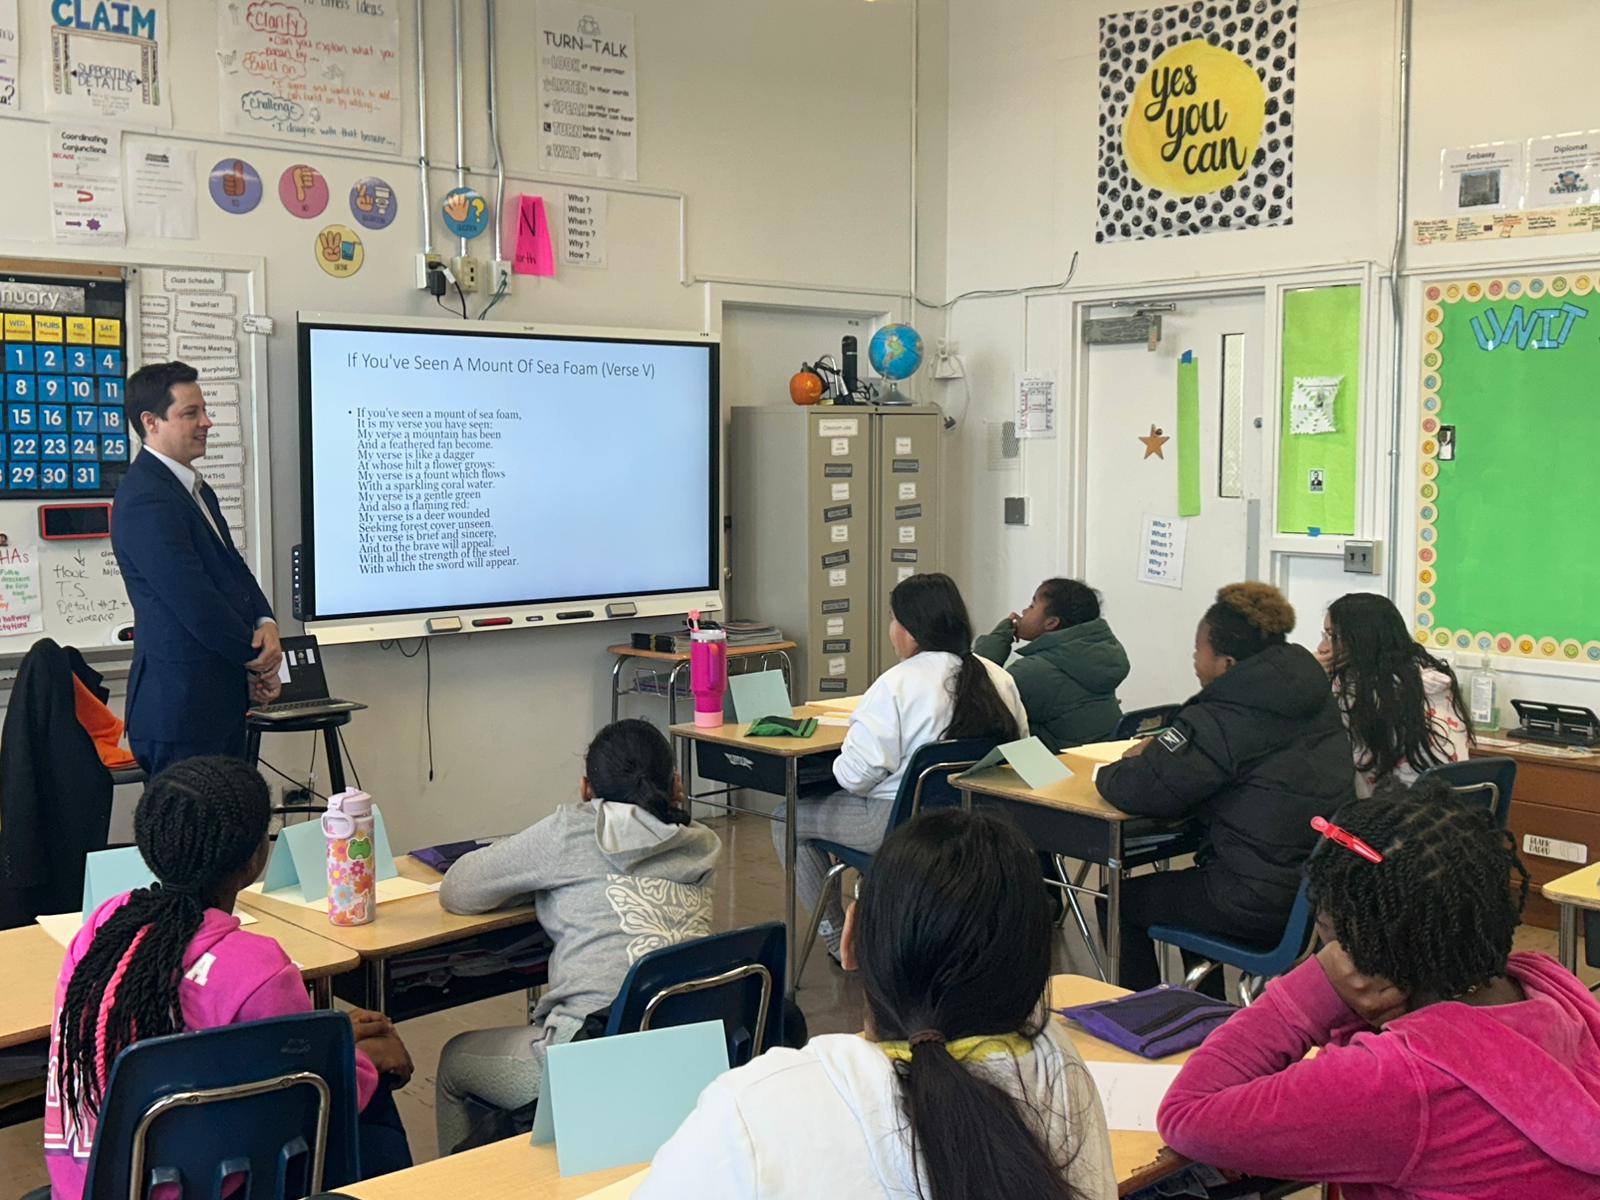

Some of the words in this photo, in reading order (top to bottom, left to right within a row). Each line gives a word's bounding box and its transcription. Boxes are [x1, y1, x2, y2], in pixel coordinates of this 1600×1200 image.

[51, 0, 156, 41] CLAIM
[255, 11, 299, 36] Clarify
[77, 62, 137, 82] SUPPORTING
[77, 73, 133, 93] DETAILS
[1144, 64, 1198, 122] yes
[249, 98, 296, 119] Challenge
[61, 132, 108, 145] Coordinating
[1160, 99, 1228, 163] you
[62, 143, 107, 154] Conjunctions
[1183, 136, 1247, 175] can
[1554, 144, 1588, 154] Diplomat
[1466, 152, 1495, 161] Embassy
[568, 194, 583, 202] Who
[568, 205, 586, 214] What
[518, 201, 536, 237] N
[568, 217, 587, 226] When
[568, 228, 591, 238] Where
[568, 239, 583, 249] Why
[568, 251, 584, 259] How
[188, 277, 215, 285] Schedule
[191, 319, 216, 329] Specials
[1469, 302, 1589, 351] UNIT
[182, 344, 207, 353] Morning
[208, 344, 232, 354] Meeting
[16, 350, 23, 365] 1
[44, 351, 56, 366] 2
[74, 352, 85, 367] 3
[103, 354, 114, 369] 4
[201, 366, 236, 375] Morphology
[347, 352, 358, 368] If
[361, 353, 410, 369] You've
[414, 355, 449, 371] Seen
[453, 356, 464, 371] A
[468, 357, 513, 373] Mount
[517, 358, 534, 373] Of
[537, 359, 559, 374] Sea
[563, 360, 598, 376] Foam
[601, 361, 640, 378] (Verse
[642, 362, 656, 379] V)
[16, 379, 27, 395] 8
[46, 381, 57, 396] 9
[72, 381, 90, 397] 10
[105, 382, 118, 398] 11
[12, 409, 31, 424] 15
[43, 410, 62, 425] 16
[76, 410, 94, 426] 17
[102, 411, 119, 427] 18
[357, 407, 366, 418] If
[367, 407, 400, 420] you've
[434, 410, 465, 419] mount
[467, 408, 478, 419] of
[479, 411, 494, 419] sea
[496, 408, 522, 420] foam,
[357, 418, 366, 428] It
[367, 418, 377, 428] is
[379, 420, 395, 430] my
[397, 420, 423, 428] verse
[424, 420, 442, 431] you
[444, 418, 467, 429] have
[468, 421, 493, 429] seen:
[357, 429, 373, 441] My
[375, 431, 402, 439] verse
[412, 429, 459, 439] mountain
[461, 429, 478, 439] has
[479, 428, 502, 439] been
[13, 439, 36, 454] 22
[44, 439, 66, 454] 23
[73, 439, 95, 455] 24
[104, 440, 125, 455] 25
[357, 439, 378, 449] And
[389, 438, 435, 449] feathered
[438, 439, 453, 449] fan
[455, 439, 494, 449] become.
[358, 449, 374, 462] My
[376, 451, 402, 460] verse
[405, 449, 413, 459] is
[415, 448, 433, 459] like
[443, 448, 475, 461] dagger
[357, 460, 369, 470] At
[371, 459, 404, 470] whose
[405, 459, 422, 469] hilt
[432, 459, 463, 469] flower
[464, 461, 495, 471] grows:
[12, 467, 35, 483] 29
[43, 468, 66, 483] 30
[77, 468, 95, 483] 31
[358, 470, 375, 483] My
[376, 472, 402, 480] verse
[405, 470, 413, 480] is
[423, 470, 449, 479] fount
[451, 469, 479, 479] which
[481, 468, 506, 479] flows
[358, 480, 383, 491] With
[393, 479, 439, 493] sparkling
[441, 479, 465, 489] coral
[466, 480, 496, 489] water.
[358, 501, 379, 511] And
[381, 501, 402, 511] also
[412, 500, 449, 511] flaming
[56, 600, 95, 614] Detail
[184, 952, 217, 987] A
